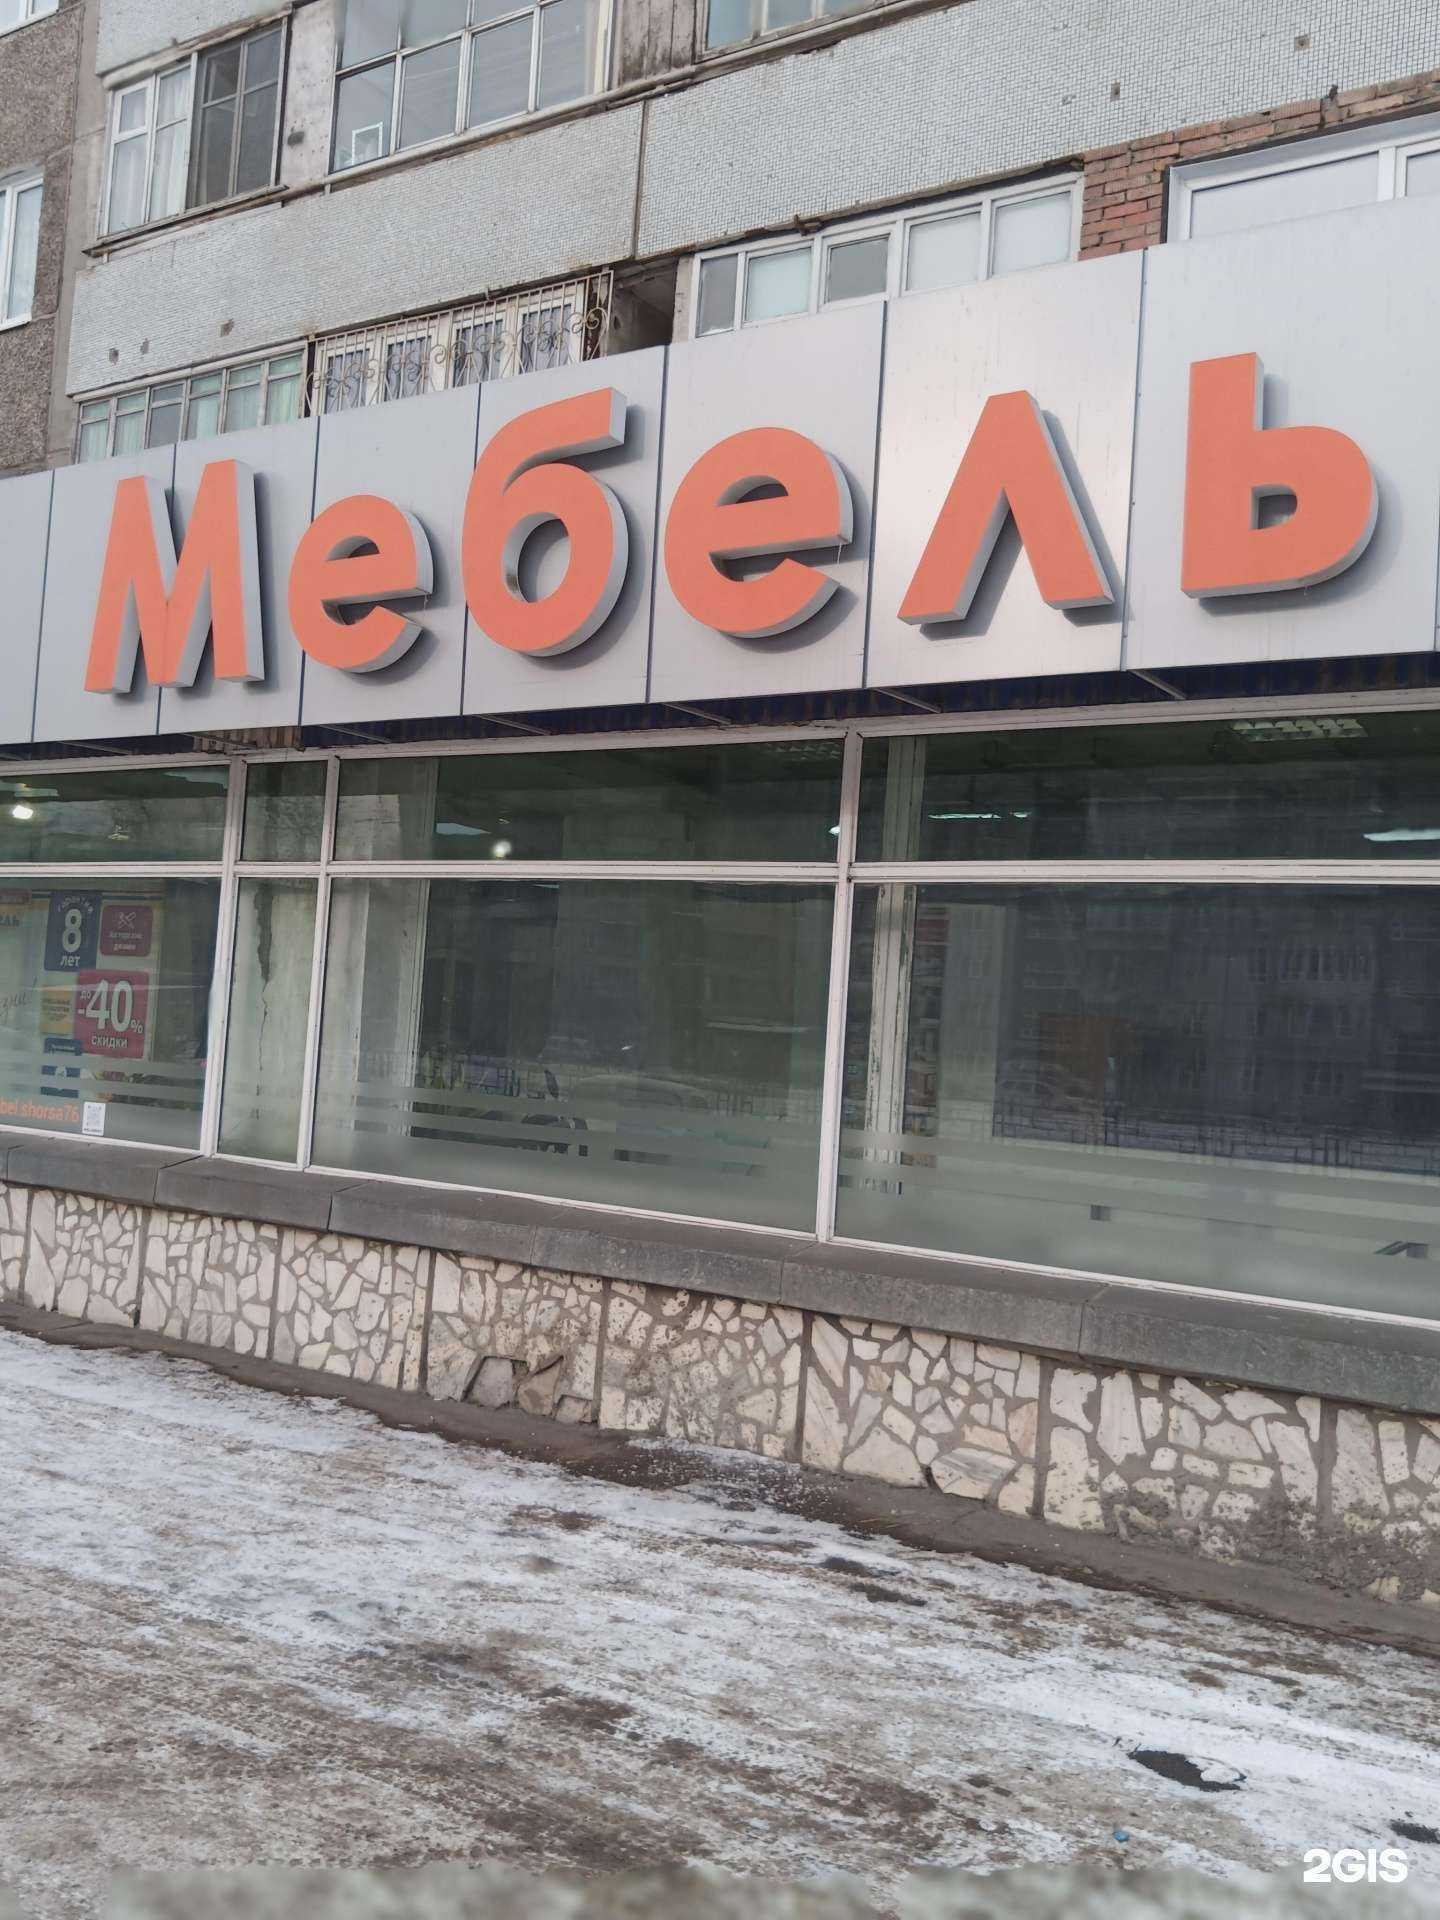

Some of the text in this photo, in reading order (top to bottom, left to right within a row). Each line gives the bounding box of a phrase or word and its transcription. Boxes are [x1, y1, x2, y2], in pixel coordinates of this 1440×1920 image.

[84, 352, 1379, 694] Мебель
[62, 908, 82, 953] 8
[60, 955, 81, 968] лет
